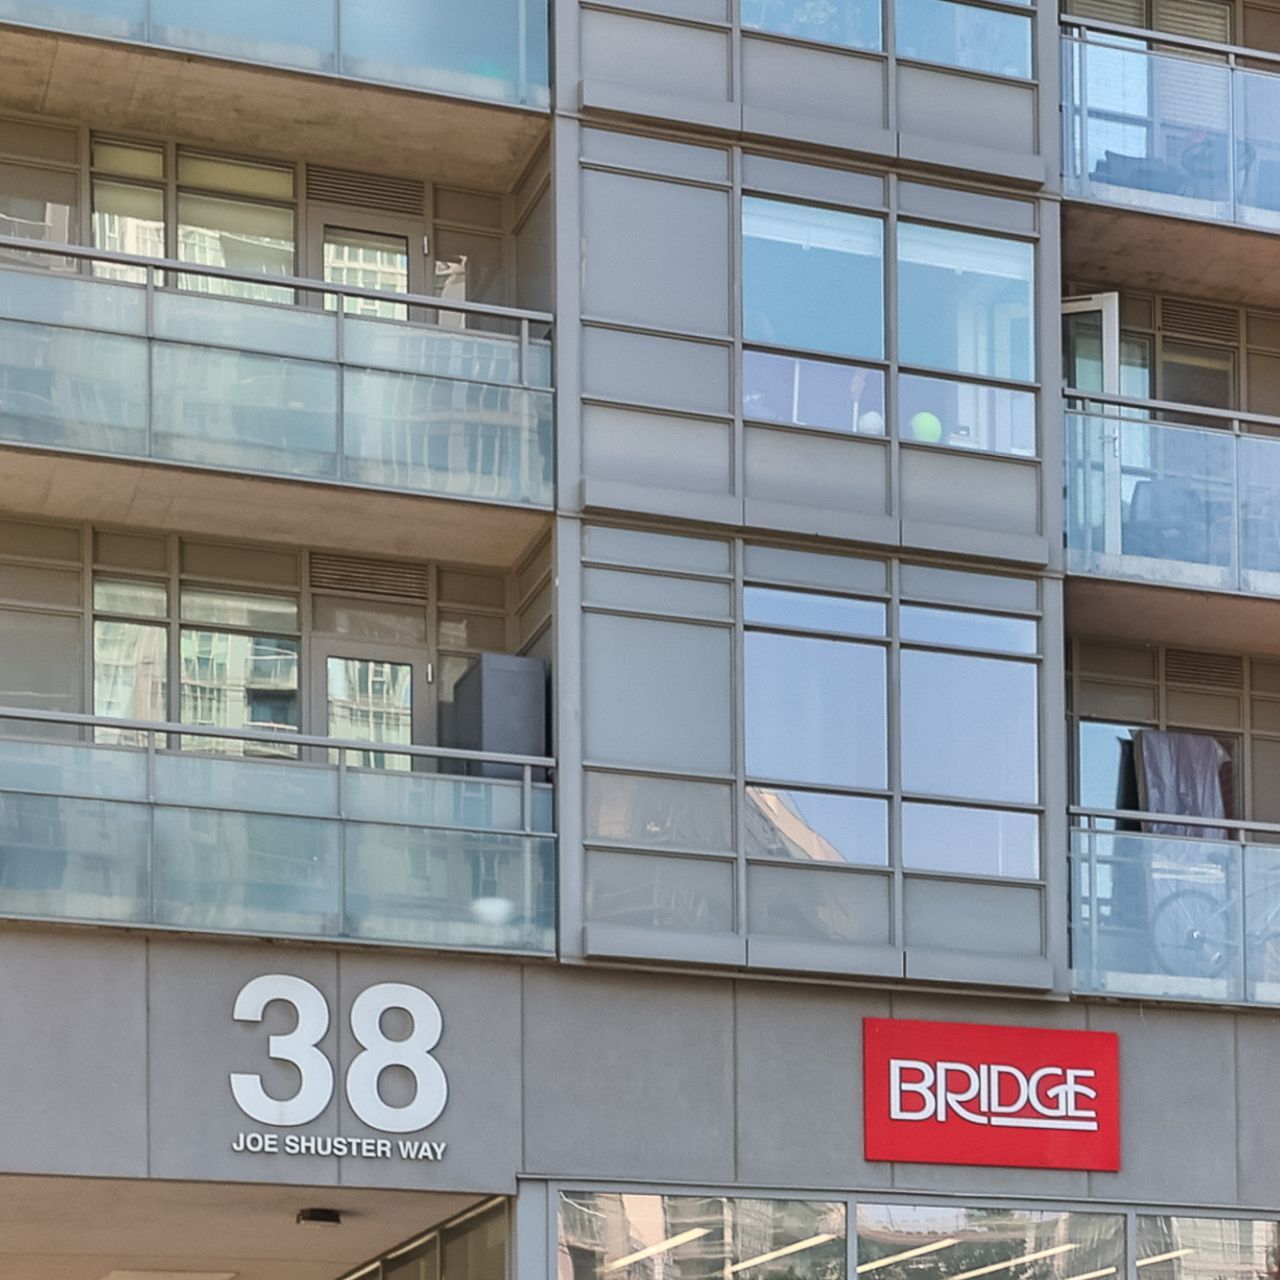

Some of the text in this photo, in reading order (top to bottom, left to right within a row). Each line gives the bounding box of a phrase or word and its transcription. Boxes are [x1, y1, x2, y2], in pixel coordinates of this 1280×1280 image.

[229, 973, 449, 1134] 38
[888, 1058, 1099, 1131] BRIDGE
[231, 1132, 447, 1161] JOE SHUSTER WAY
